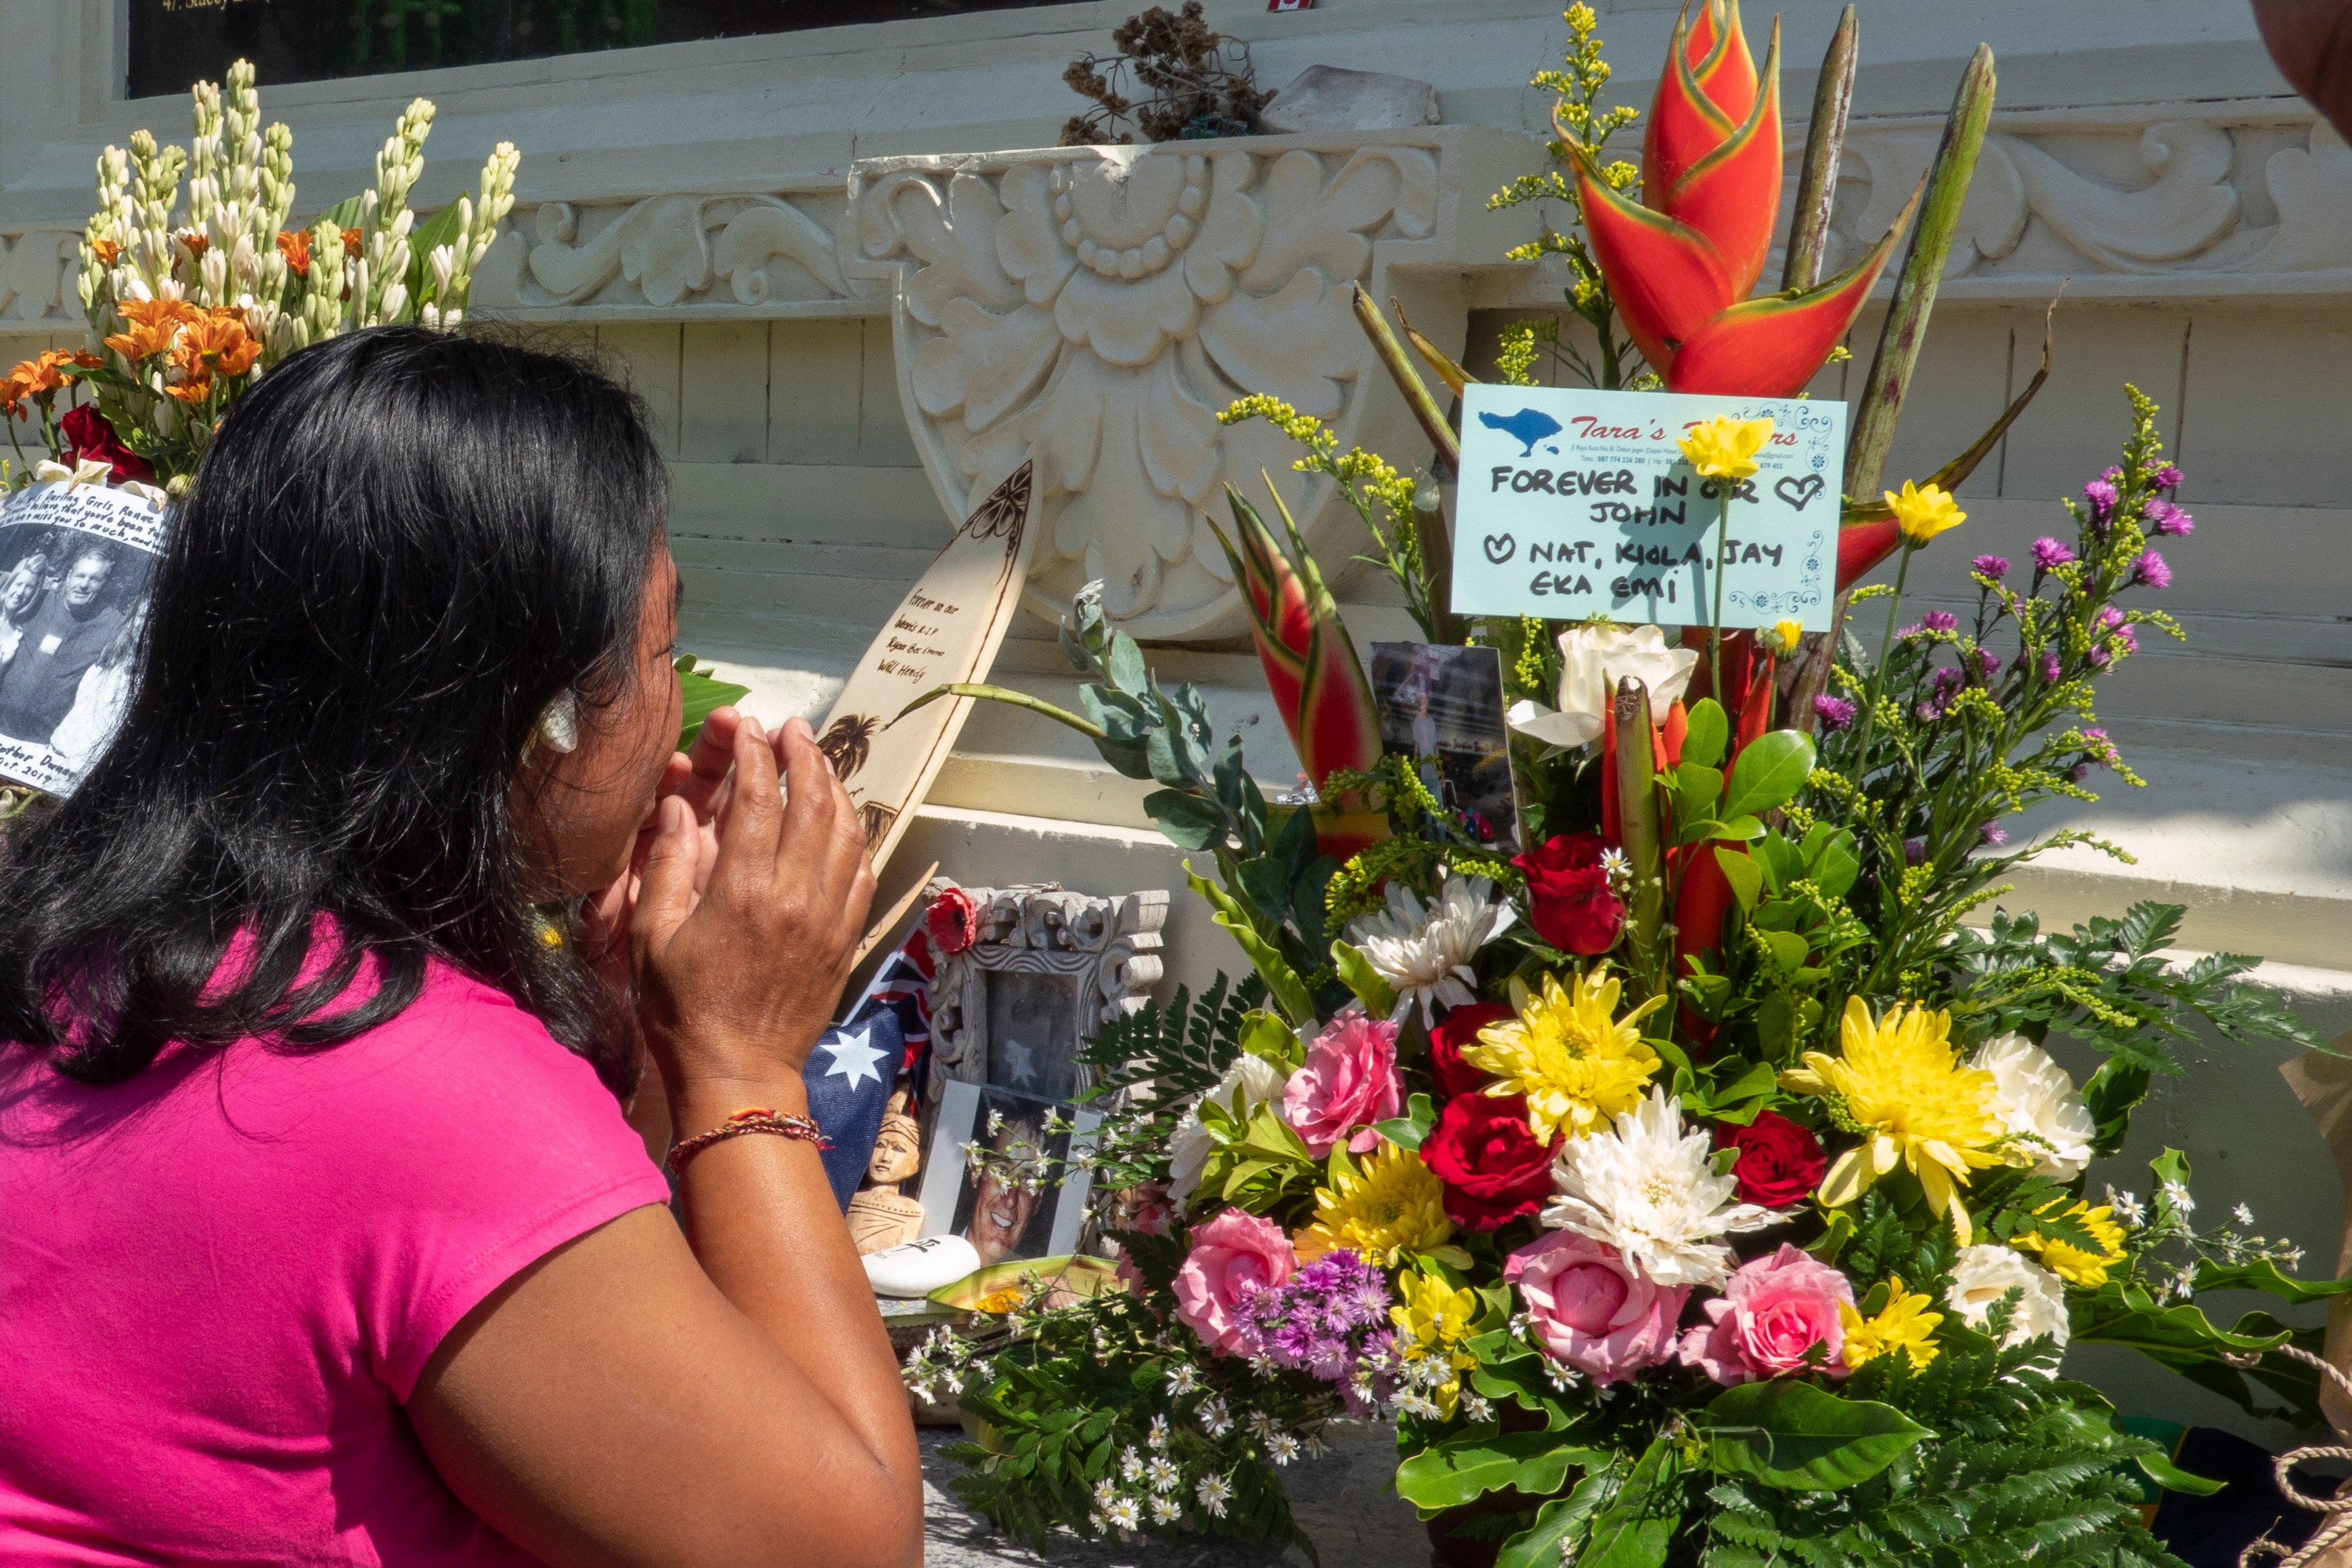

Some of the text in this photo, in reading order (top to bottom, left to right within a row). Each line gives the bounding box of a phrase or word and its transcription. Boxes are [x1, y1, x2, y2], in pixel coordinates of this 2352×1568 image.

[1571, 416, 1667, 441] Tara's
[1490, 466, 1638, 495] FOREVER
[1654, 474, 1688, 497] IN
[43, 490, 79, 508] Darling
[61, 503, 85, 515] that
[117, 516, 143, 533] been
[1590, 500, 1687, 527] JOHN
[51, 515, 72, 525] you
[74, 518, 85, 528] so
[90, 524, 128, 541] much,
[131, 537, 152, 547] and
[1529, 541, 1602, 570] NAT,
[1723, 539, 1783, 567] JAY
[1530, 570, 1593, 596] EKA
[933, 601, 945, 612] in
[944, 605, 959, 615] our
[877, 659, 900, 675] Will
[0, 744, 33, 761] other
[22, 766, 52, 786] 2019
